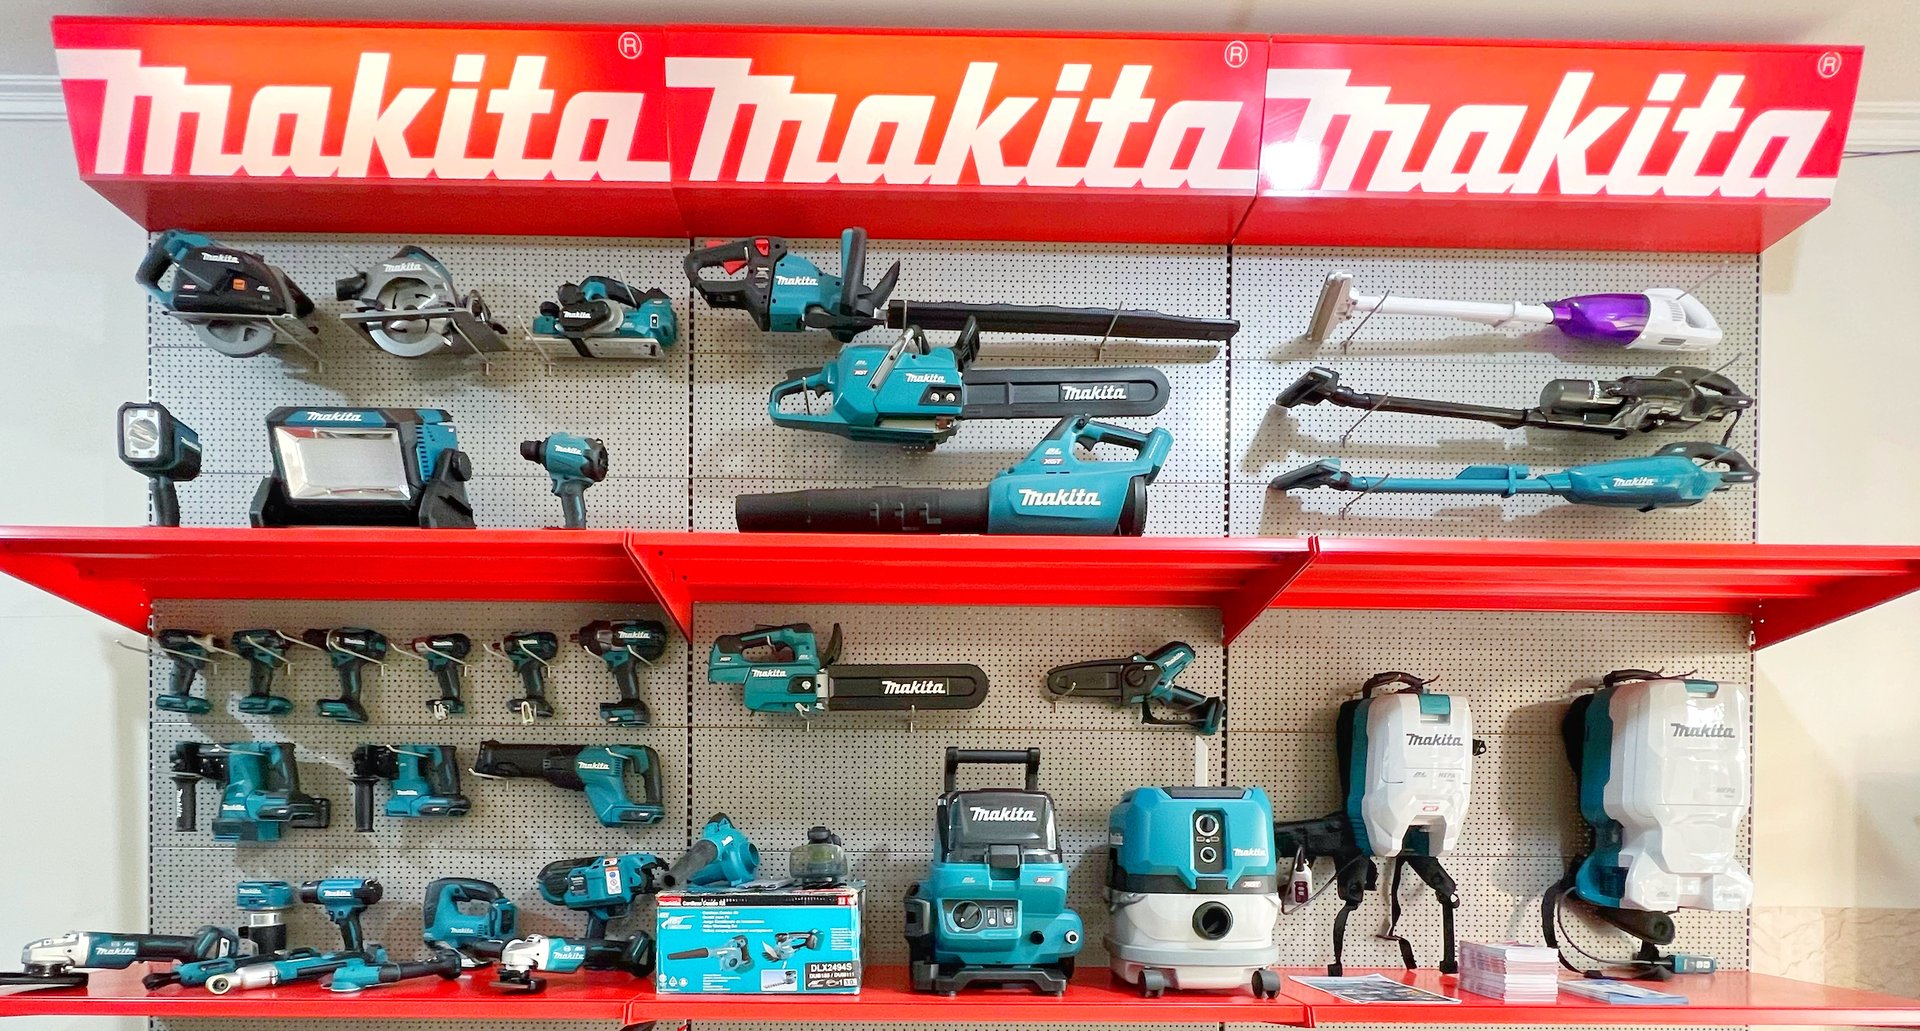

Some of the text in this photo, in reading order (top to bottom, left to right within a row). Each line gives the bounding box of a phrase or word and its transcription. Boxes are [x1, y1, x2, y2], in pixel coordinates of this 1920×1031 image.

[54, 48, 671, 182] Makita
[665, 57, 1257, 189] Makita
[1266, 69, 1838, 199] Makita
[775, 275, 819, 286] Makita
[1062, 385, 1127, 401] Makita
[307, 411, 362, 422] Makita
[1019, 488, 1101, 506] Makita
[882, 680, 946, 695] Makita
[1670, 723, 1736, 739] Makita
[1406, 733, 1464, 746] Makita
[970, 806, 1038, 822] Makita
